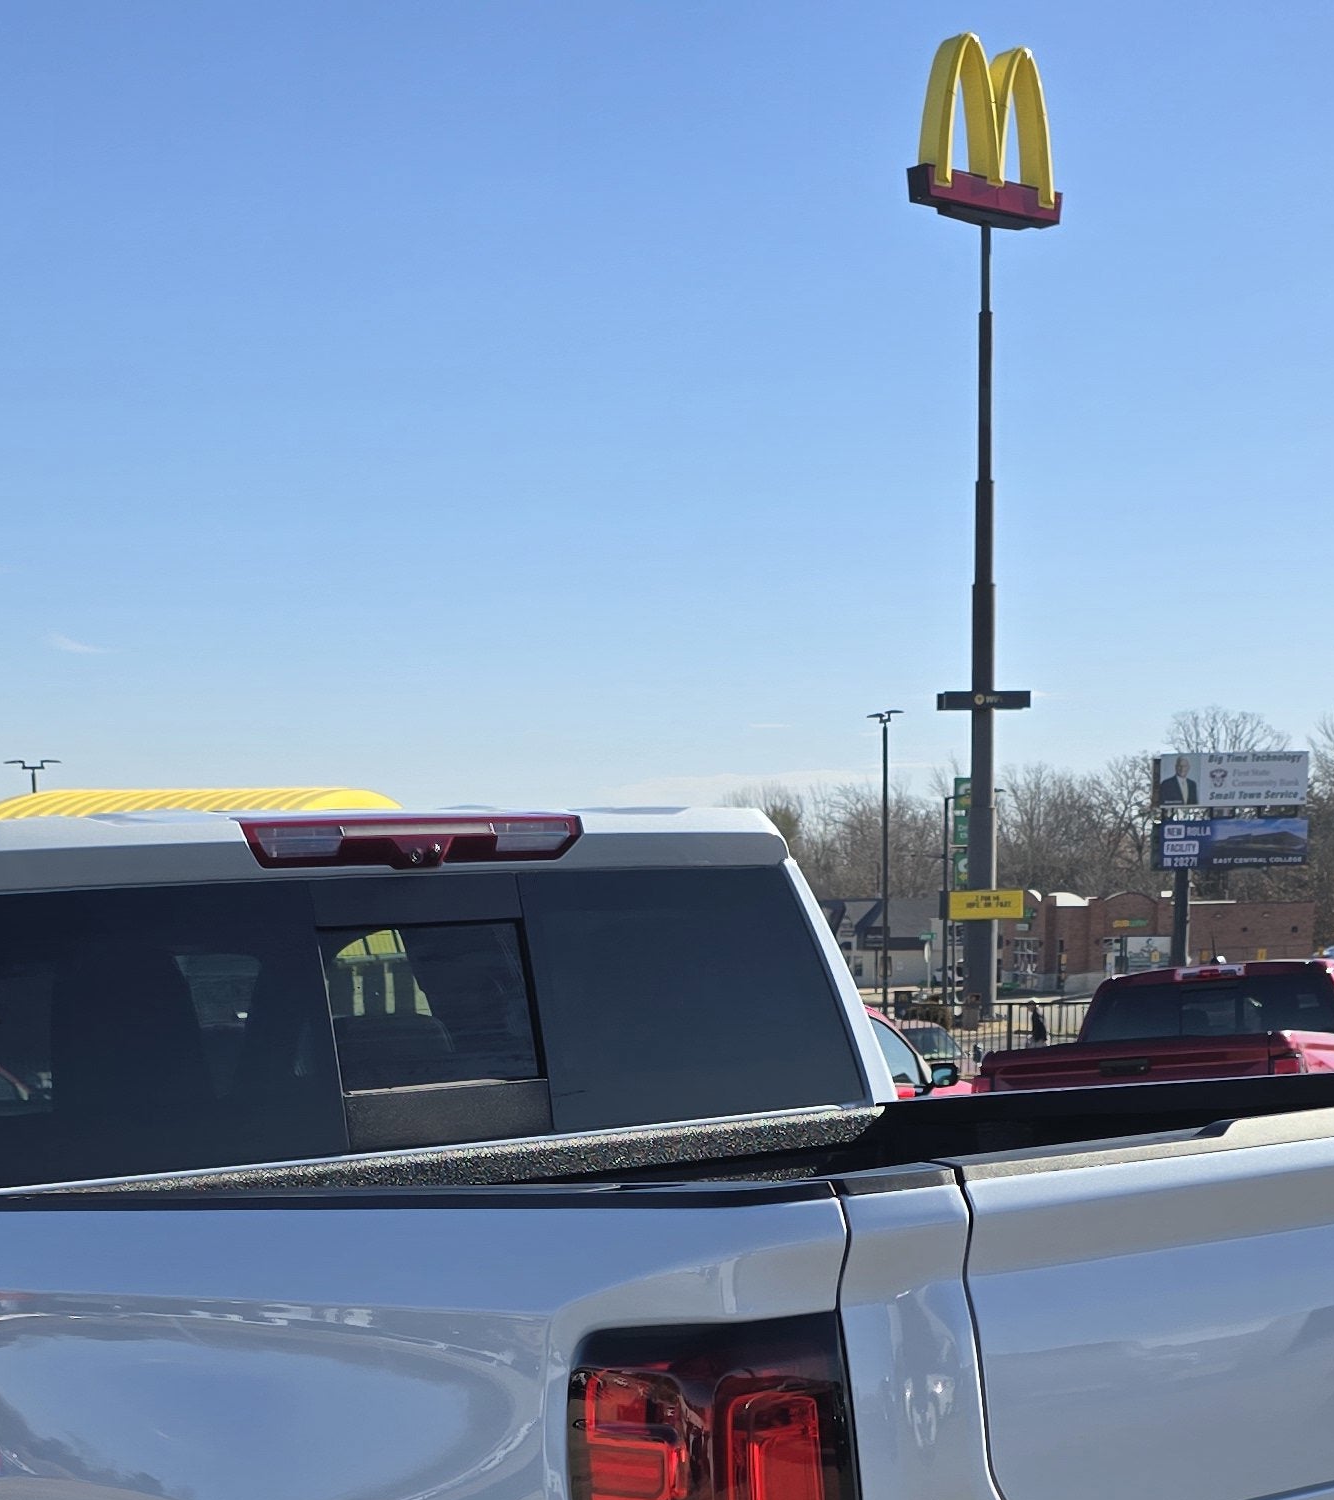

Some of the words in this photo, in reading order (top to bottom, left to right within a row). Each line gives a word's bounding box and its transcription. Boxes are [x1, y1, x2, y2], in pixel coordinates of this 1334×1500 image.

[1207, 754, 1224, 765] Big
[1226, 754, 1248, 763] Time
[1251, 753, 1303, 764] Technology
[1209, 791, 1236, 801] Small
[1238, 790, 1262, 800] Town
[1264, 790, 1299, 800] Service
[1166, 827, 1184, 837] NEW
[1186, 826, 1212, 837] ROLLA
[1166, 843, 1198, 854] FACILITY
